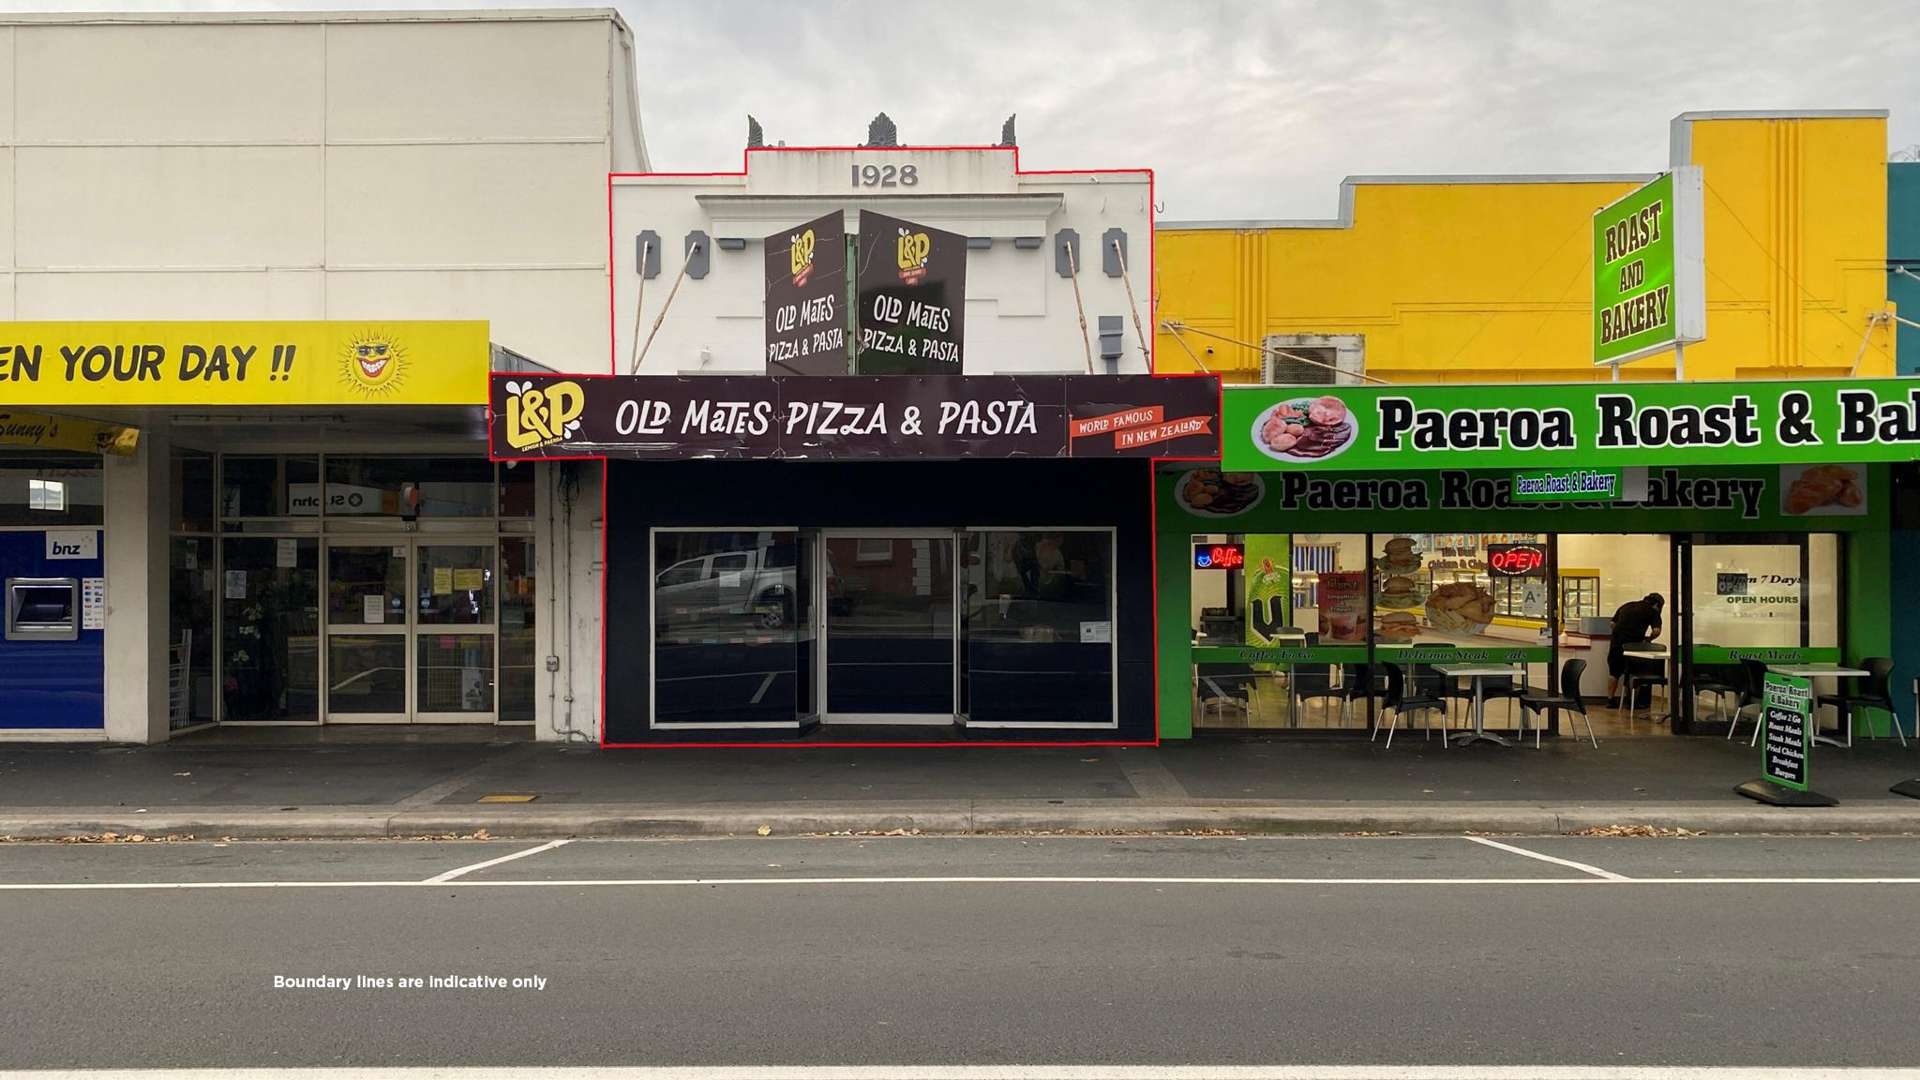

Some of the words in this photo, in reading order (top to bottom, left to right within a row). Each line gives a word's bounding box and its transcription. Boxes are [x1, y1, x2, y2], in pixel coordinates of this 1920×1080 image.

[852, 164, 918, 188] 1928
[1605, 201, 1662, 263] ROAST
[896, 232, 931, 269] L&P
[1619, 259, 1644, 293] AND
[775, 303, 797, 333] OLD
[873, 295, 903, 324] OLD
[1601, 286, 1669, 344] BAKERY
[769, 339, 799, 362] PIZZA
[802, 338, 809, 356] &
[813, 328, 843, 353] PASTA
[864, 328, 904, 355] PIZZA
[909, 339, 917, 356] &
[922, 339, 959, 362] PASTA
[59, 344, 166, 382] YOUR
[178, 344, 257, 382] DAY
[269, 344, 296, 382] !!
[505, 380, 585, 449] L&P
[615, 400, 672, 435] OLD
[786, 400, 888, 436] PIZZA
[900, 405, 924, 436] &
[937, 400, 1038, 435] PASTA
[1113, 411, 1153, 427] FAMOUS
[1376, 397, 1575, 450] Paeroa
[1596, 394, 1760, 448] Roast
[1777, 390, 1823, 445] &
[1837, 389, 1920, 444] Ba
[1122, 433, 1133, 445] IN
[1136, 428, 1157, 442] NEW
[1280, 471, 1431, 510] Paeroa
[1516, 475, 1545, 494] Paeroa
[1545, 473, 1571, 493] Roast
[1571, 473, 1578, 492] &
[1580, 471, 1616, 496] Bakery
[1613, 468, 1766, 519] akery
[52, 541, 81, 555] bnz
[1212, 547, 1243, 567] Coffee
[1492, 552, 1543, 568] OPEN
[1761, 575, 1769, 584] 7
[1770, 574, 1801, 587] Days
[1726, 596, 1757, 604] OPEN
[1760, 596, 1799, 604] HOURS
[1770, 711, 1787, 722] Coffee
[1767, 743, 1781, 754] Fried
